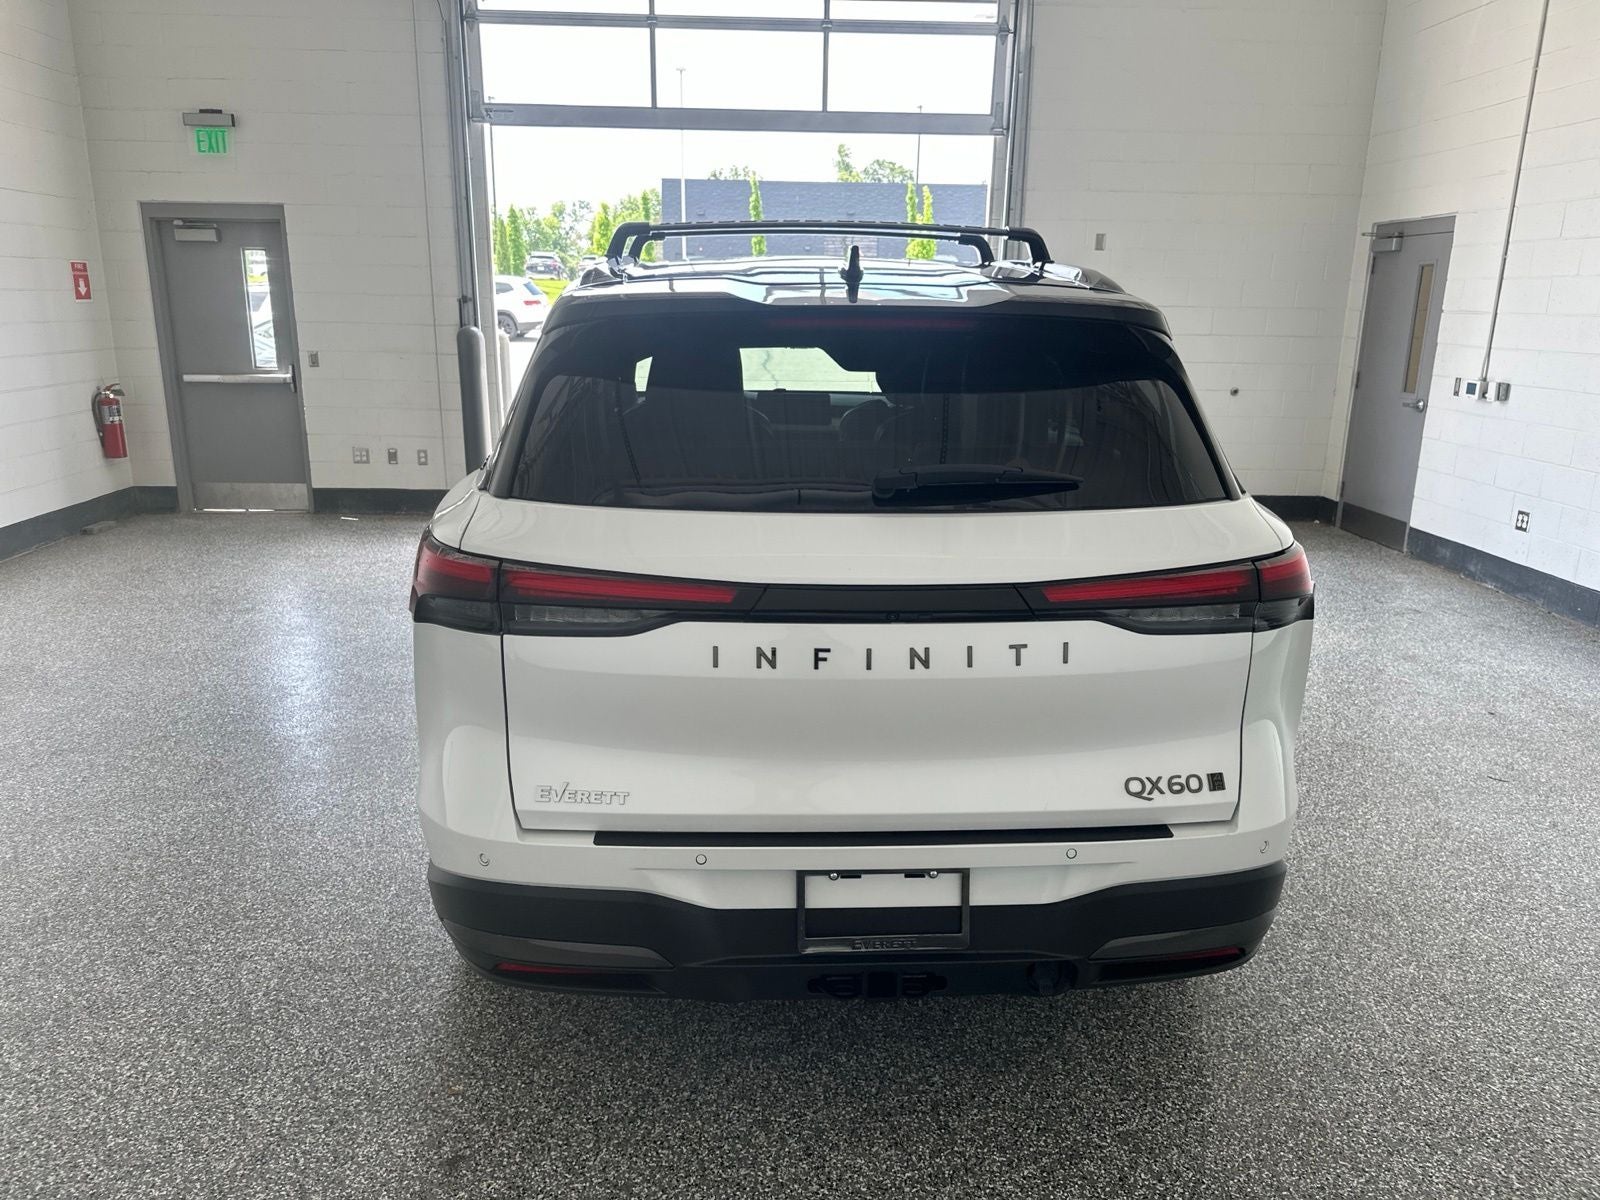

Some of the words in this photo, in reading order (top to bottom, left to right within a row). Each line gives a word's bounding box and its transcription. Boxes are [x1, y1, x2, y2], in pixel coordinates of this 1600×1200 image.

[195, 129, 227, 153] EXIT
[712, 641, 1069, 670] INFINITI
[534, 781, 630, 805] EVERETT
[1124, 773, 1204, 801] QX60
